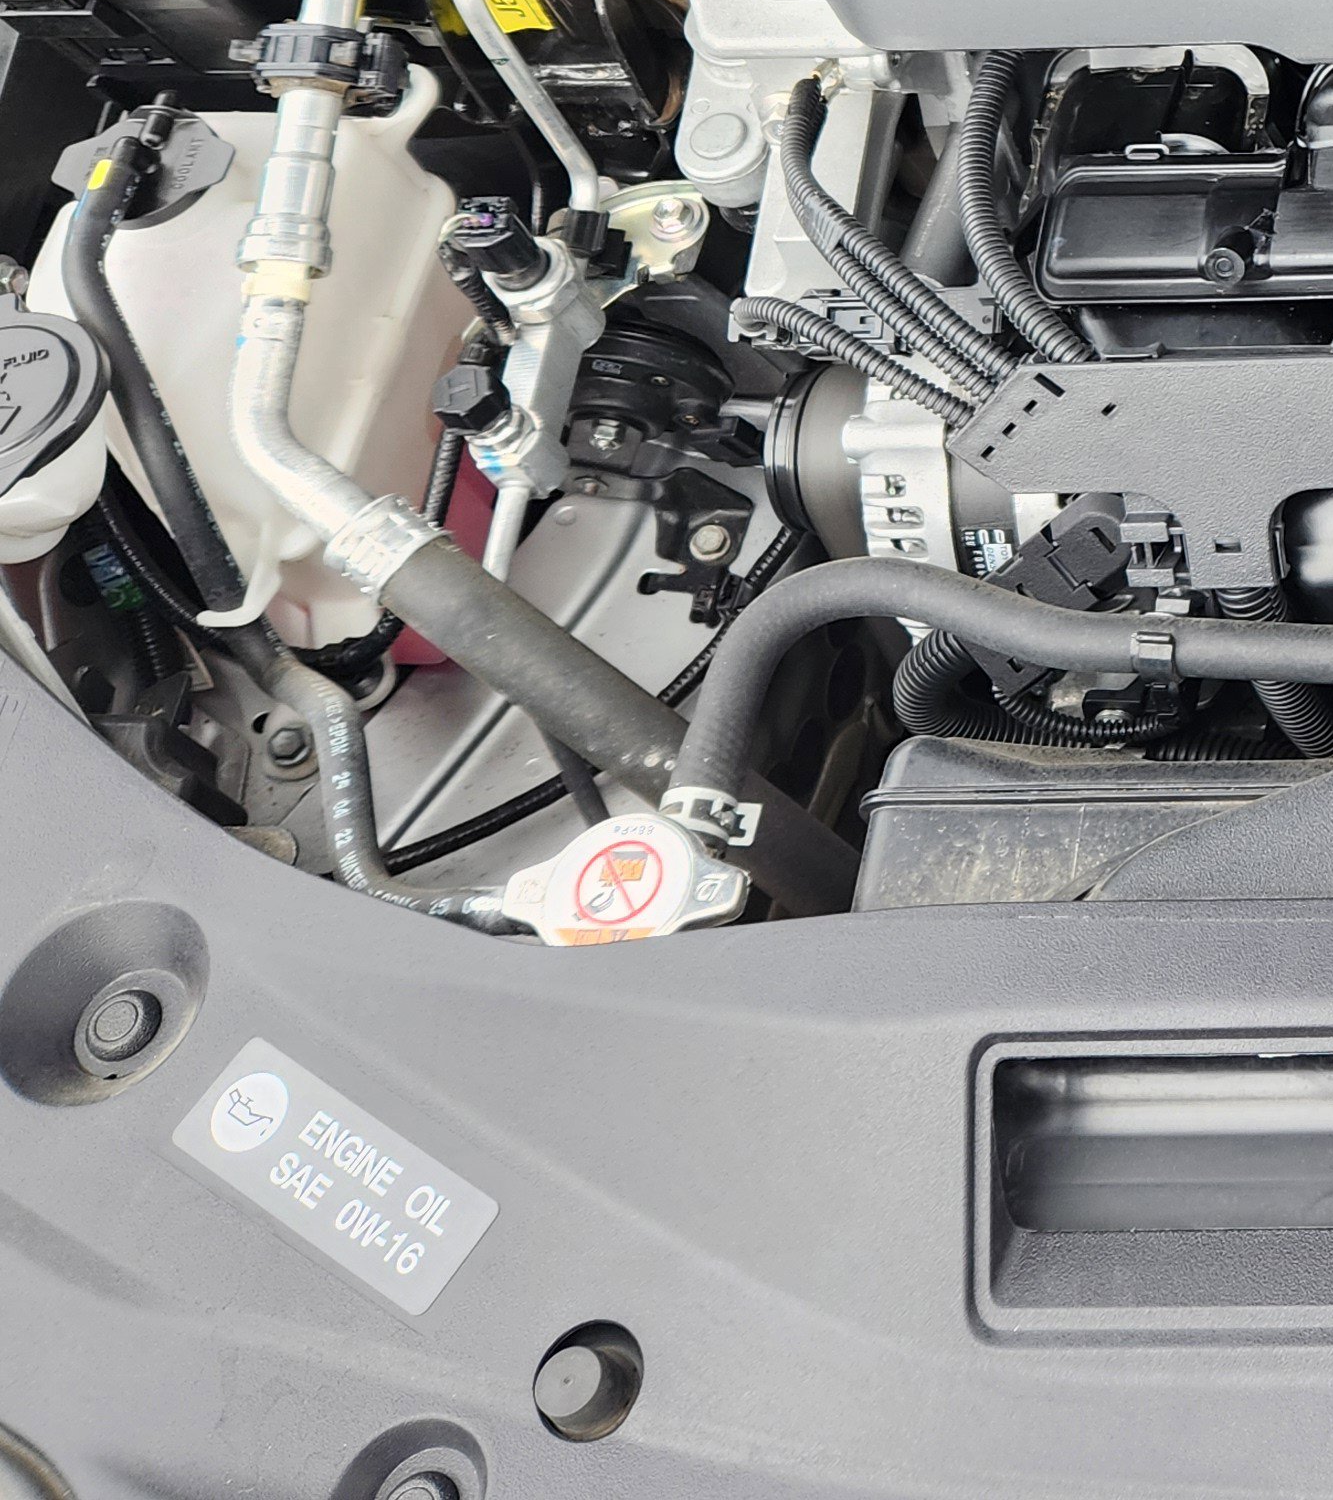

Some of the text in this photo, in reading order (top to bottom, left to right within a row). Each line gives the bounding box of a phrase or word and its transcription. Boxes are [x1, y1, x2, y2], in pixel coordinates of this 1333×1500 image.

[171, 137, 206, 192] COOLANT
[3, 348, 50, 370] FLUID
[267, 1151, 426, 1278] SAE 0W-16
[298, 1110, 453, 1239] ENGINE OIL
